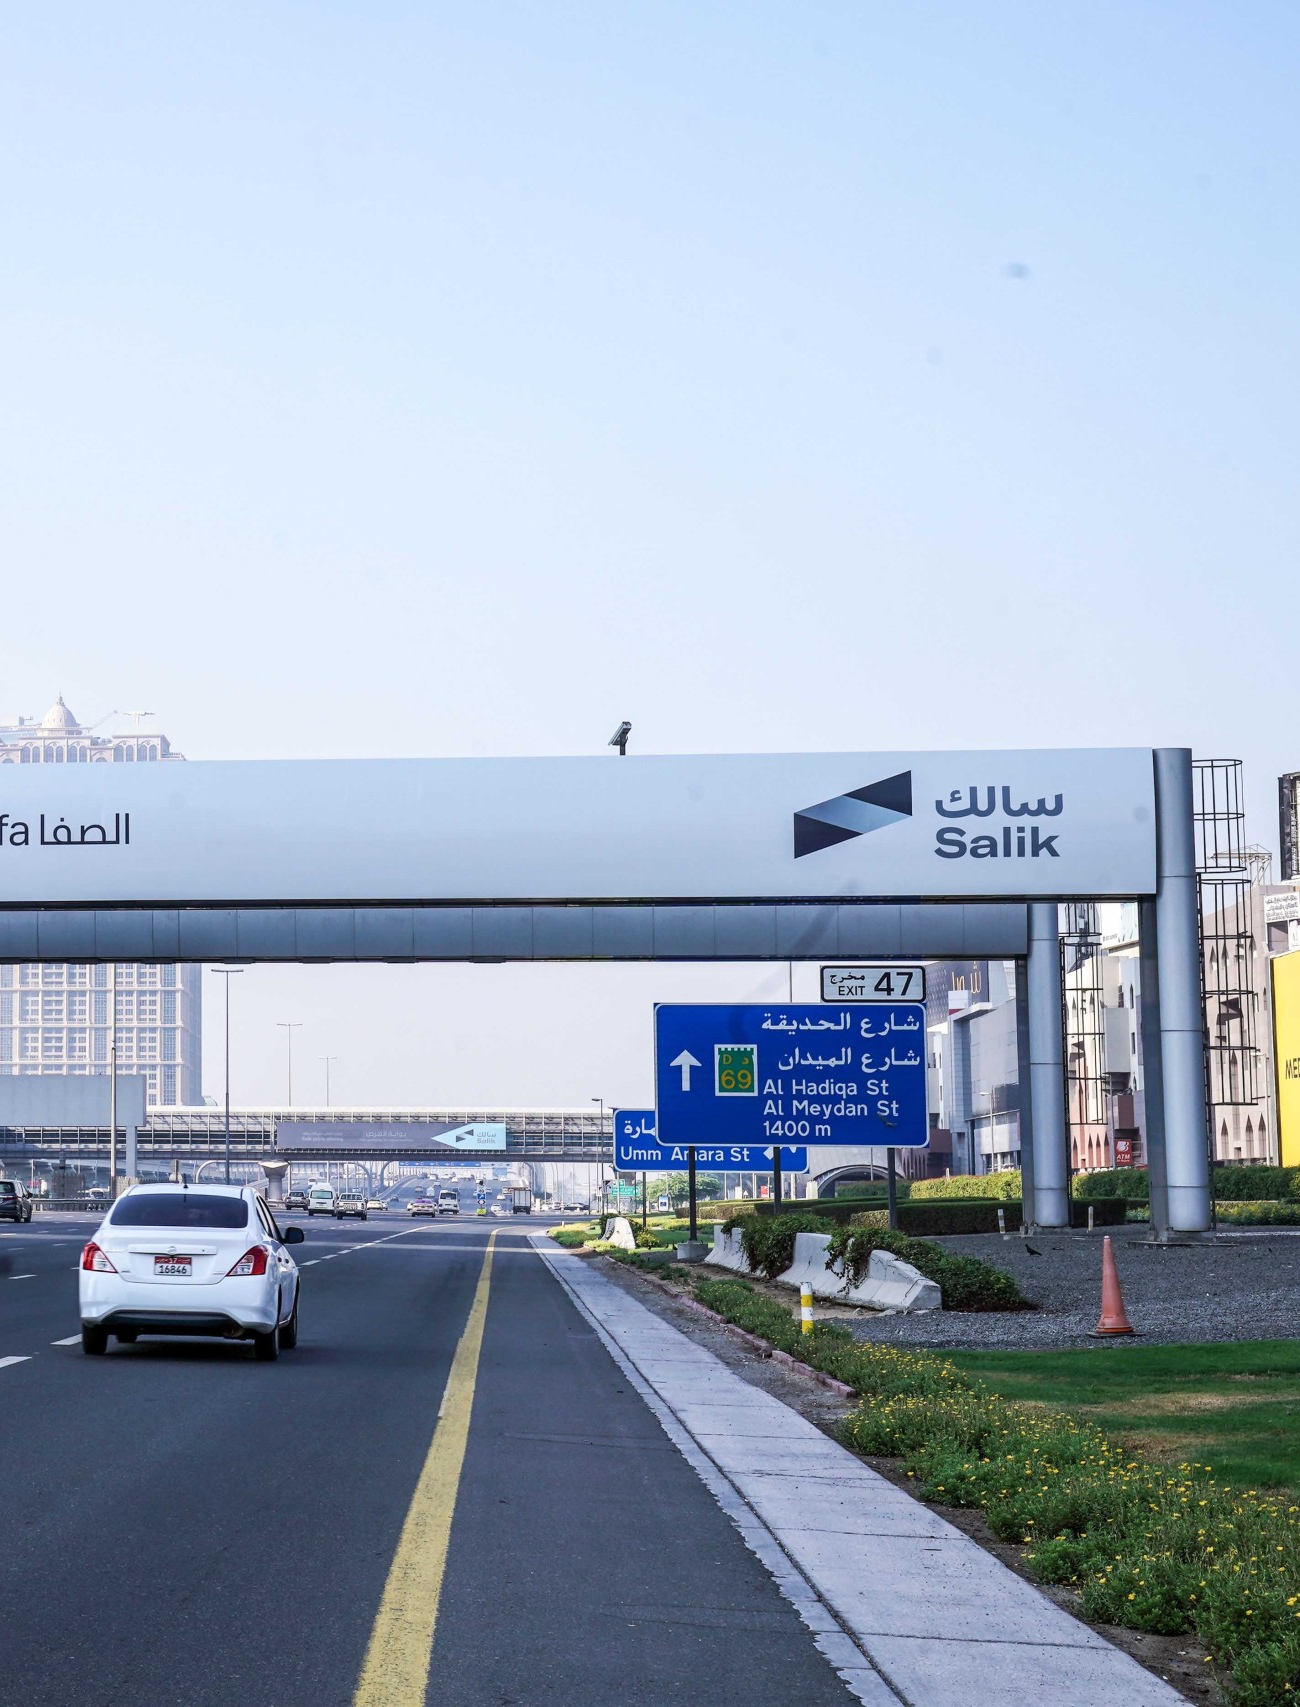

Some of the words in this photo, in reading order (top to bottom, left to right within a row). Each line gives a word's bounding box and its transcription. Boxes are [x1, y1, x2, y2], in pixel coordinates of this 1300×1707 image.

[935, 785, 1063, 818] سالك
[40, 812, 130, 846] الصفا
[934, 826, 1060, 859] Salik
[829, 971, 866, 984] مخرج
[874, 971, 913, 996] 47
[838, 985, 865, 996] EXIT
[761, 1011, 851, 1036] الحديقة
[860, 1011, 920, 1038] شارع
[722, 1054, 732, 1065] D
[778, 1046, 852, 1071] الميدان
[861, 1047, 921, 1074] شارع
[721, 1069, 752, 1089] 69
[763, 1078, 784, 1095] Al
[792, 1078, 858, 1099] Hadiqa
[866, 1079, 889, 1096] St
[763, 1099, 784, 1116] Al
[792, 1099, 868, 1119] Meydan
[876, 1100, 899, 1117] St
[763, 1120, 810, 1137] 1400
[815, 1124, 831, 1137] m
[620, 1145, 661, 1161] Umm
[730, 1147, 750, 1162] St
[158, 1265, 187, 1274] 16846
